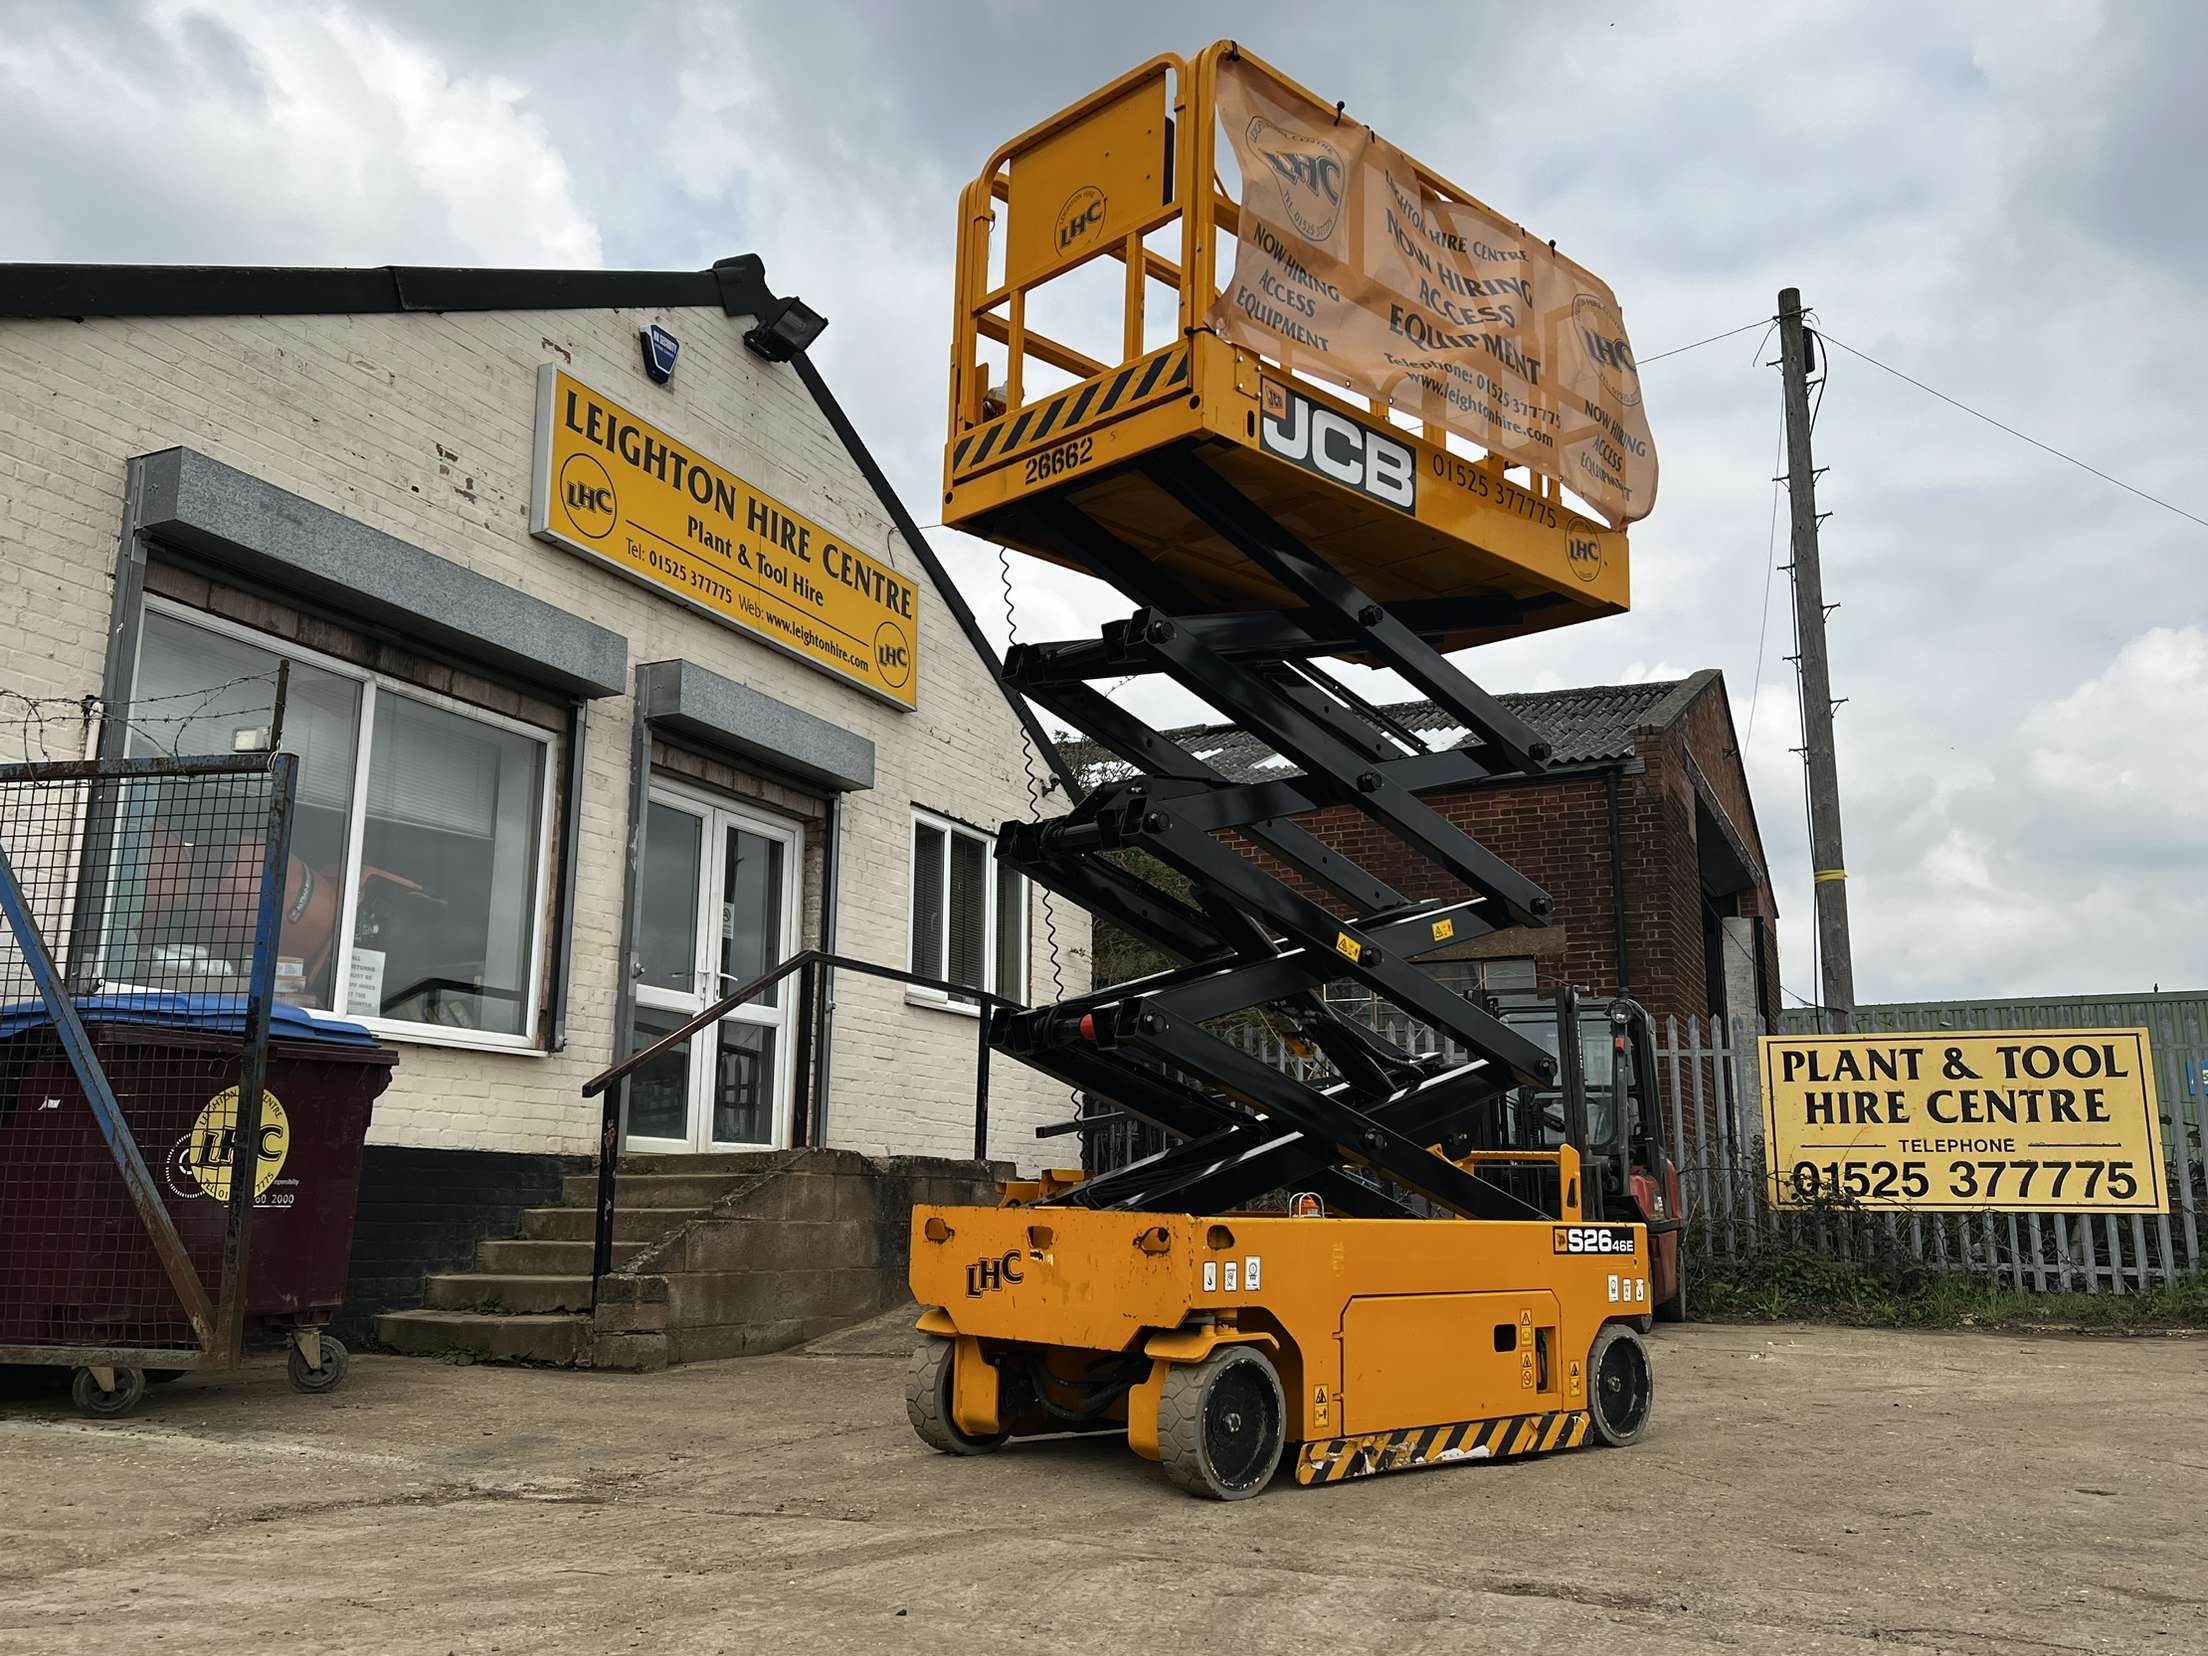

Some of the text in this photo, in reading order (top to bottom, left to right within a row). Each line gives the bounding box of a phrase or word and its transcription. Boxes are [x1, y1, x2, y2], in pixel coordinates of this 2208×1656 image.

[1060, 200, 1103, 249] LHC
[1429, 230, 1467, 253] HIRE
[1473, 241, 1529, 263] CENTRE
[1253, 221, 1288, 265] NOW
[1284, 254, 1340, 303] HIRING
[1386, 208, 1533, 309] NOW HIRING
[1259, 267, 1316, 318] ACCESS
[1419, 276, 1515, 328] ACCESS
[1236, 285, 1329, 352] EQUIPMENT
[1390, 302, 1541, 386] EQUIPMENT
[1384, 352, 1561, 430] Telephone: 01525 377775
[1406, 371, 1553, 448] www.leightonhire.com
[1262, 396, 1414, 508] JCB
[1584, 400, 1646, 458] NOW HIRING
[1593, 432, 1624, 472] ACCESS
[1025, 436, 1093, 486] 26662
[565, 389, 912, 620] LEIGHTON HIRE CENTRE
[567, 480, 613, 516] LHC
[1432, 453, 1557, 529] 01525 377775
[687, 515, 824, 607] Plant & Tool Hire
[1568, 538, 1600, 561] LHC
[626, 537, 869, 672] Tel: 01525 377775 Web: www.leightonhire.com
[879, 643, 908, 668] LHC
[1781, 1044, 2128, 1083] PLANT & TOOL
[1804, 1088, 2111, 1125] HIRE CENTRE
[1898, 1138, 2016, 1153] TELEPHONE
[271, 1194, 295, 1204] 2000
[1793, 1160, 2138, 1200] 01525 377775
[965, 1249, 1024, 1298] LHC
